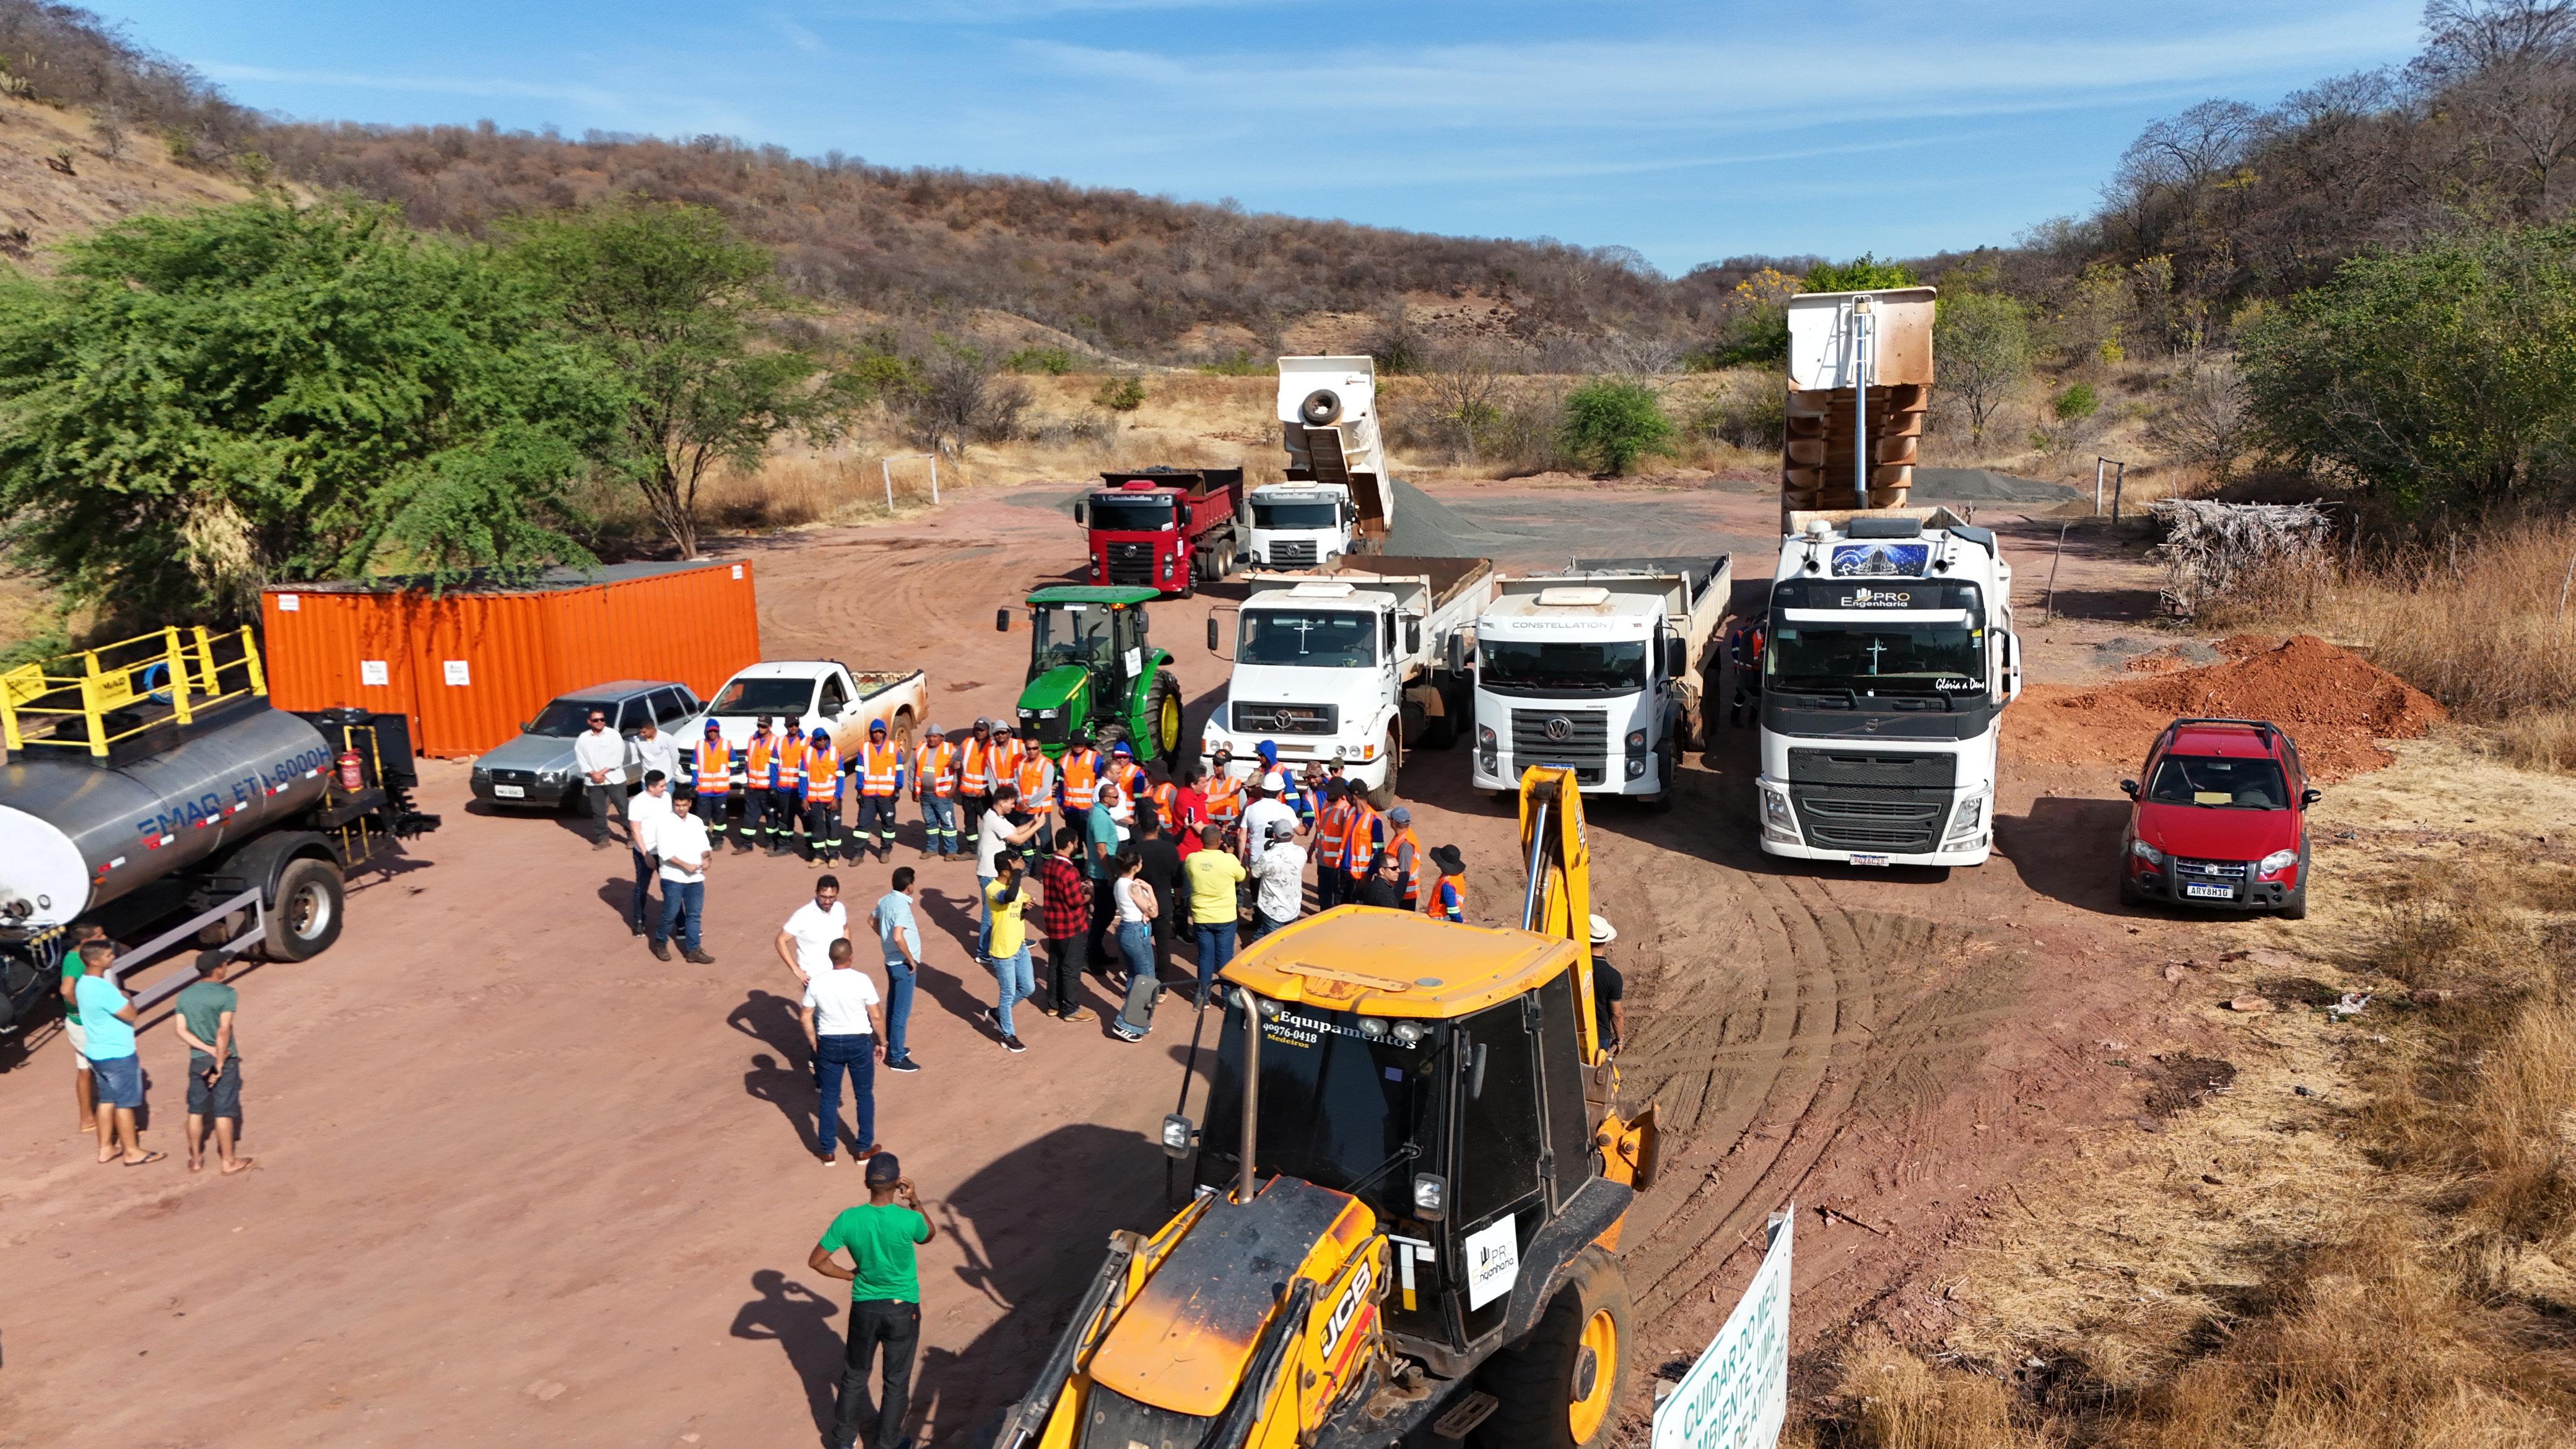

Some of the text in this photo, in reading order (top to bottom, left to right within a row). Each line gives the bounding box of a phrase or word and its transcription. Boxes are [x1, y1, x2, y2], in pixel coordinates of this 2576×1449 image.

[1841, 596, 1908, 607] Engenharia
[1874, 593, 1910, 601] PRO
[1936, 678, 1960, 691] Glória
[1970, 677, 1985, 690] Deus
[137, 793, 221, 845] EMAQ
[1267, 1033, 1309, 1049] Medeiros
[1491, 1241, 1515, 1264] PRO
[1472, 1258, 1515, 1287] Engenharia
[1323, 1261, 1372, 1357] JCB
[1684, 1269, 1778, 1440] CUIDAR DO MEIO
[1757, 1316, 1775, 1375] UMA
